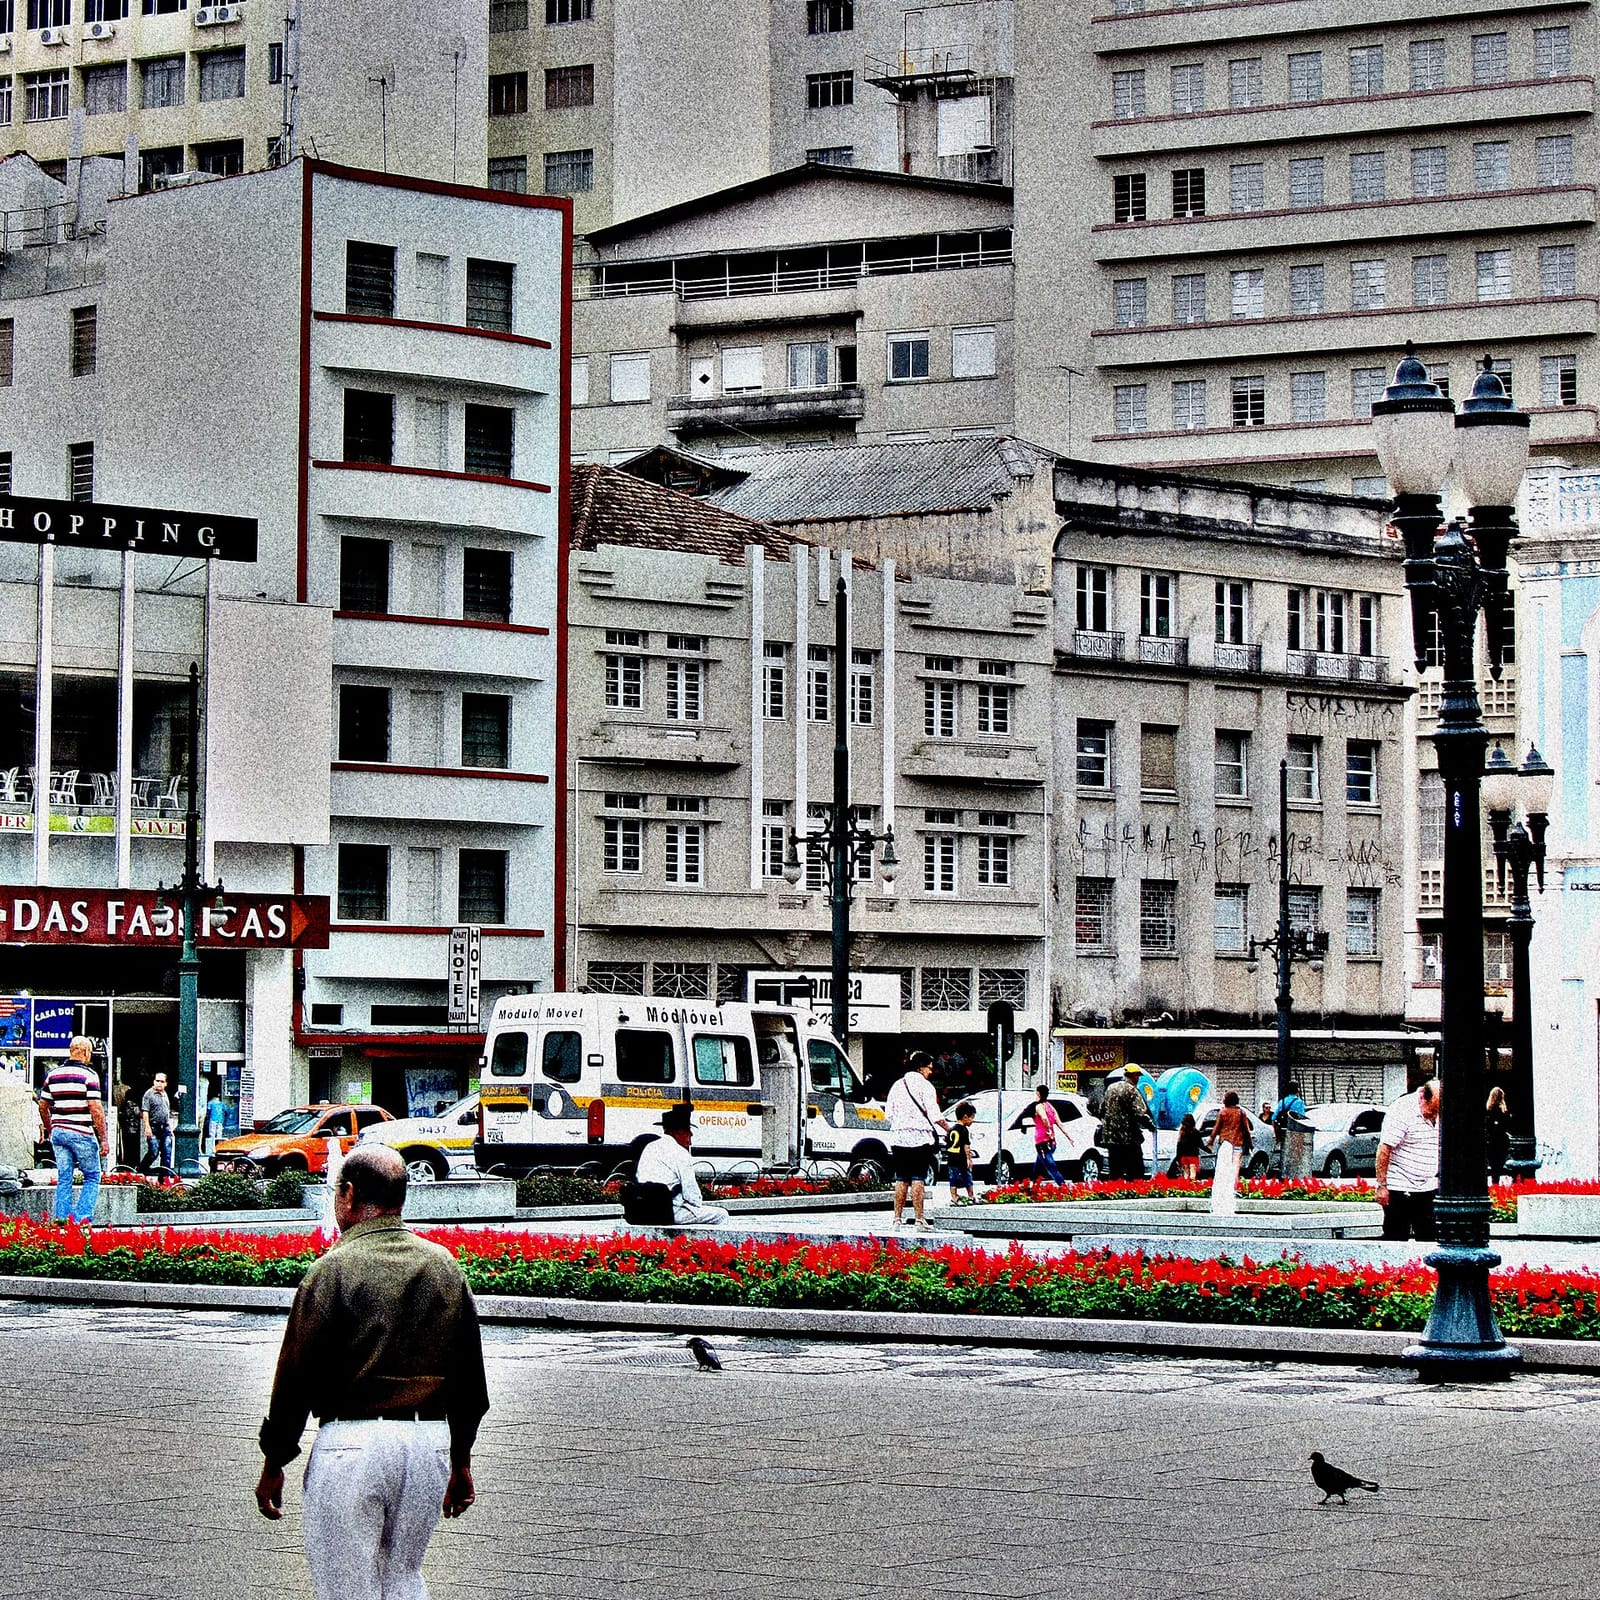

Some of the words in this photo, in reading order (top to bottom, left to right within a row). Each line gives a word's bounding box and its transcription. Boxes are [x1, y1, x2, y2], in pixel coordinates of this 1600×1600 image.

[0, 815, 26, 829] ER
[72, 817, 85, 832] &
[13, 899, 89, 933] DAS
[106, 900, 287, 938] FABICAS
[453, 943, 465, 1008] HOTEL
[470, 929, 479, 1017] HOTEL
[498, 1008, 539, 1020] Módulo
[545, 1007, 584, 1019] Móvel
[418, 1125, 448, 1135] 9437
[947, 1129, 961, 1154] 2
